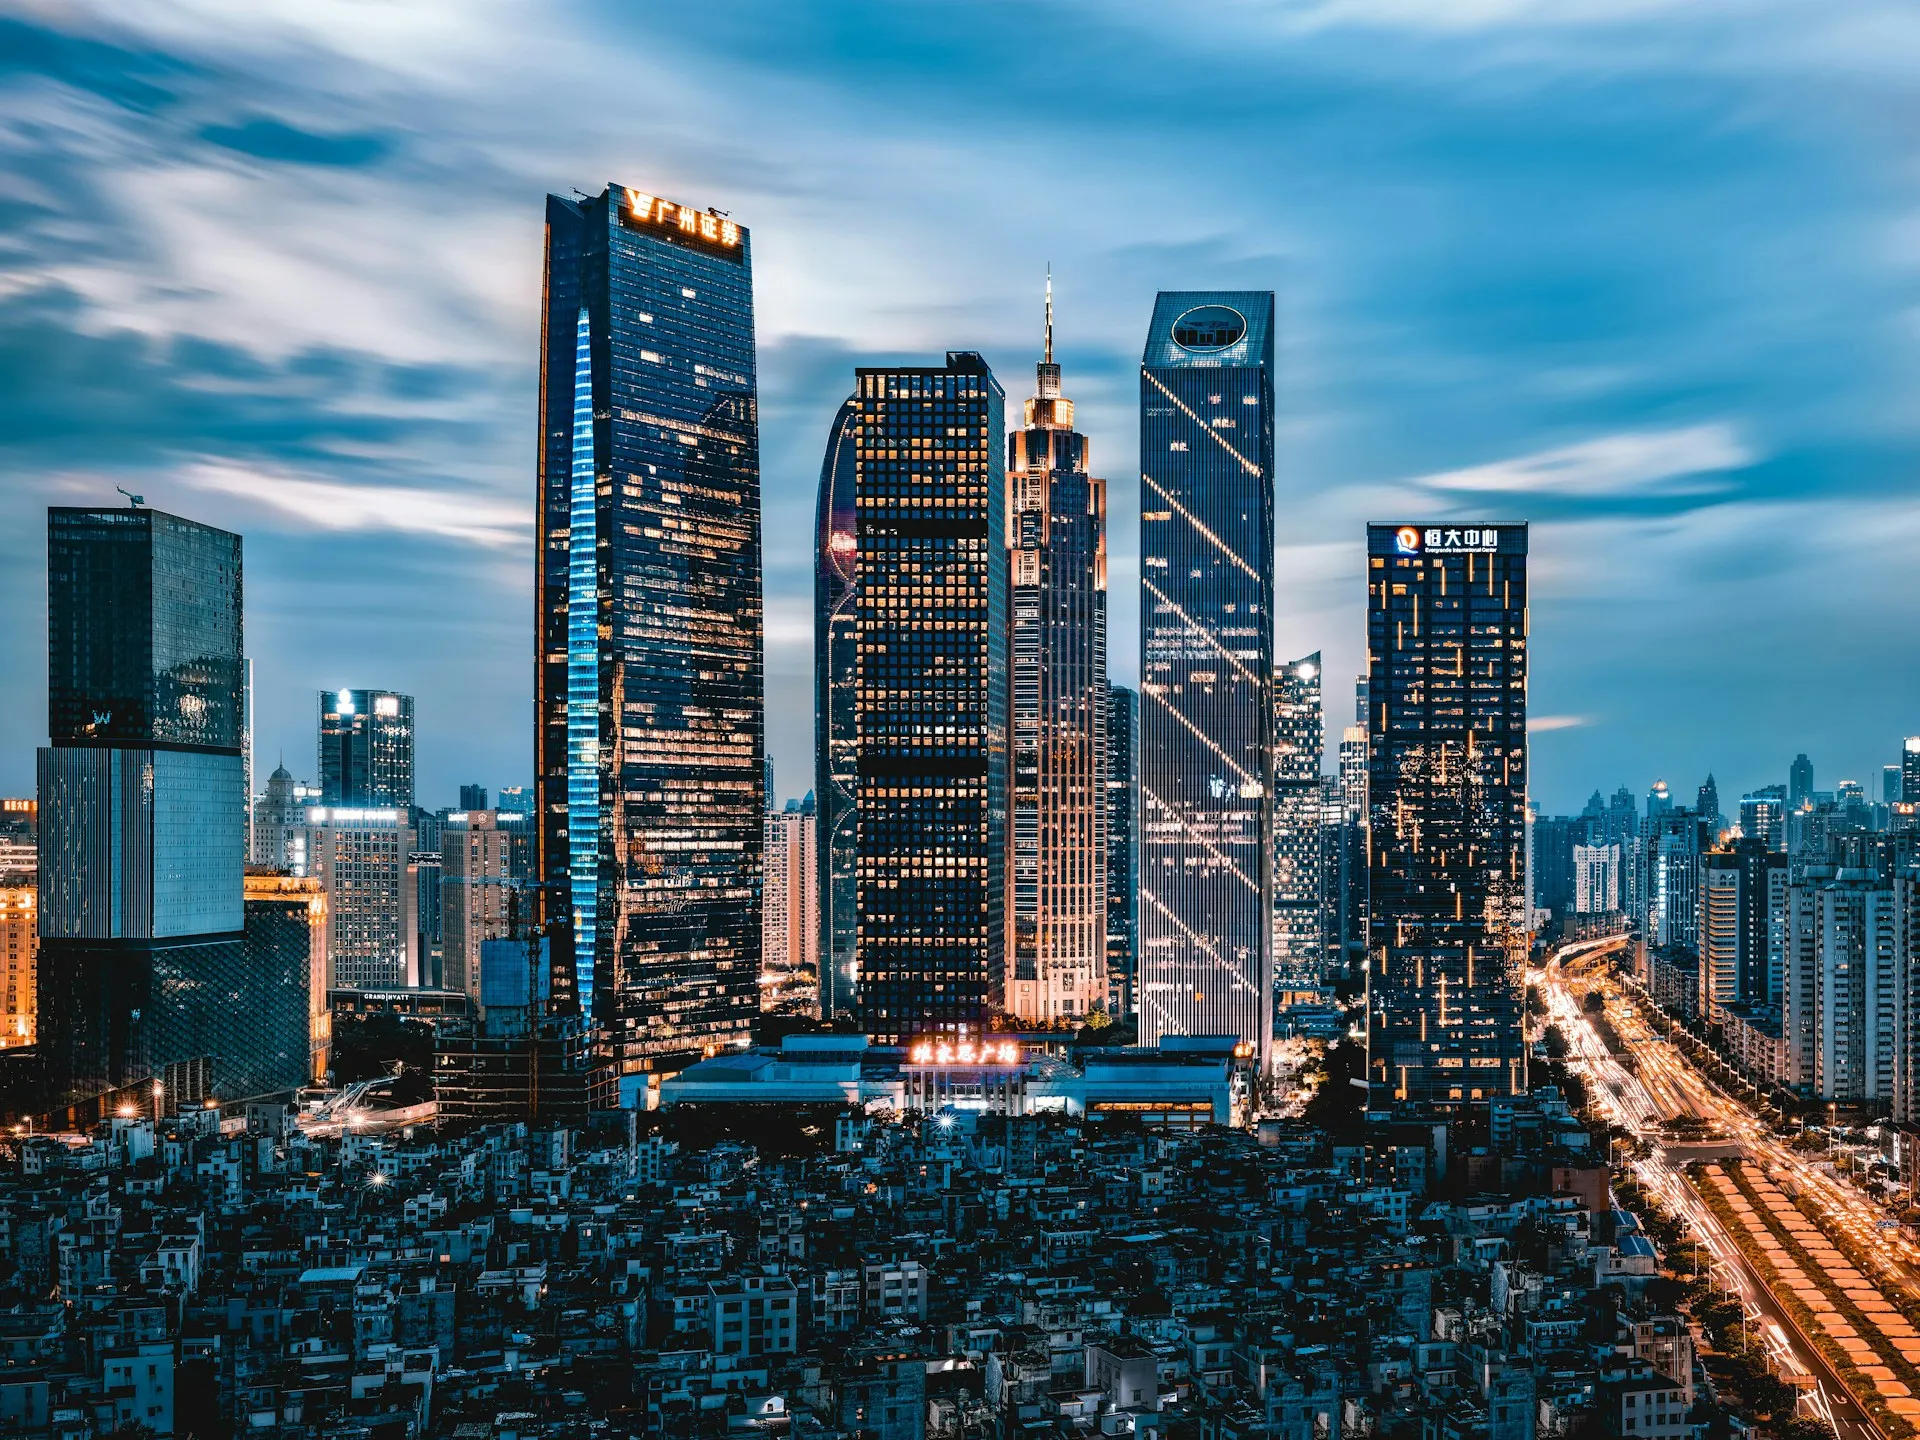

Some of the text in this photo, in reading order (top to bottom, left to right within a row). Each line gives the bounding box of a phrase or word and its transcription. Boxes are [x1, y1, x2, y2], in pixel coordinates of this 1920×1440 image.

[657, 200, 739, 246] 广州证券
[1424, 529, 1498, 546] 恒大中心
